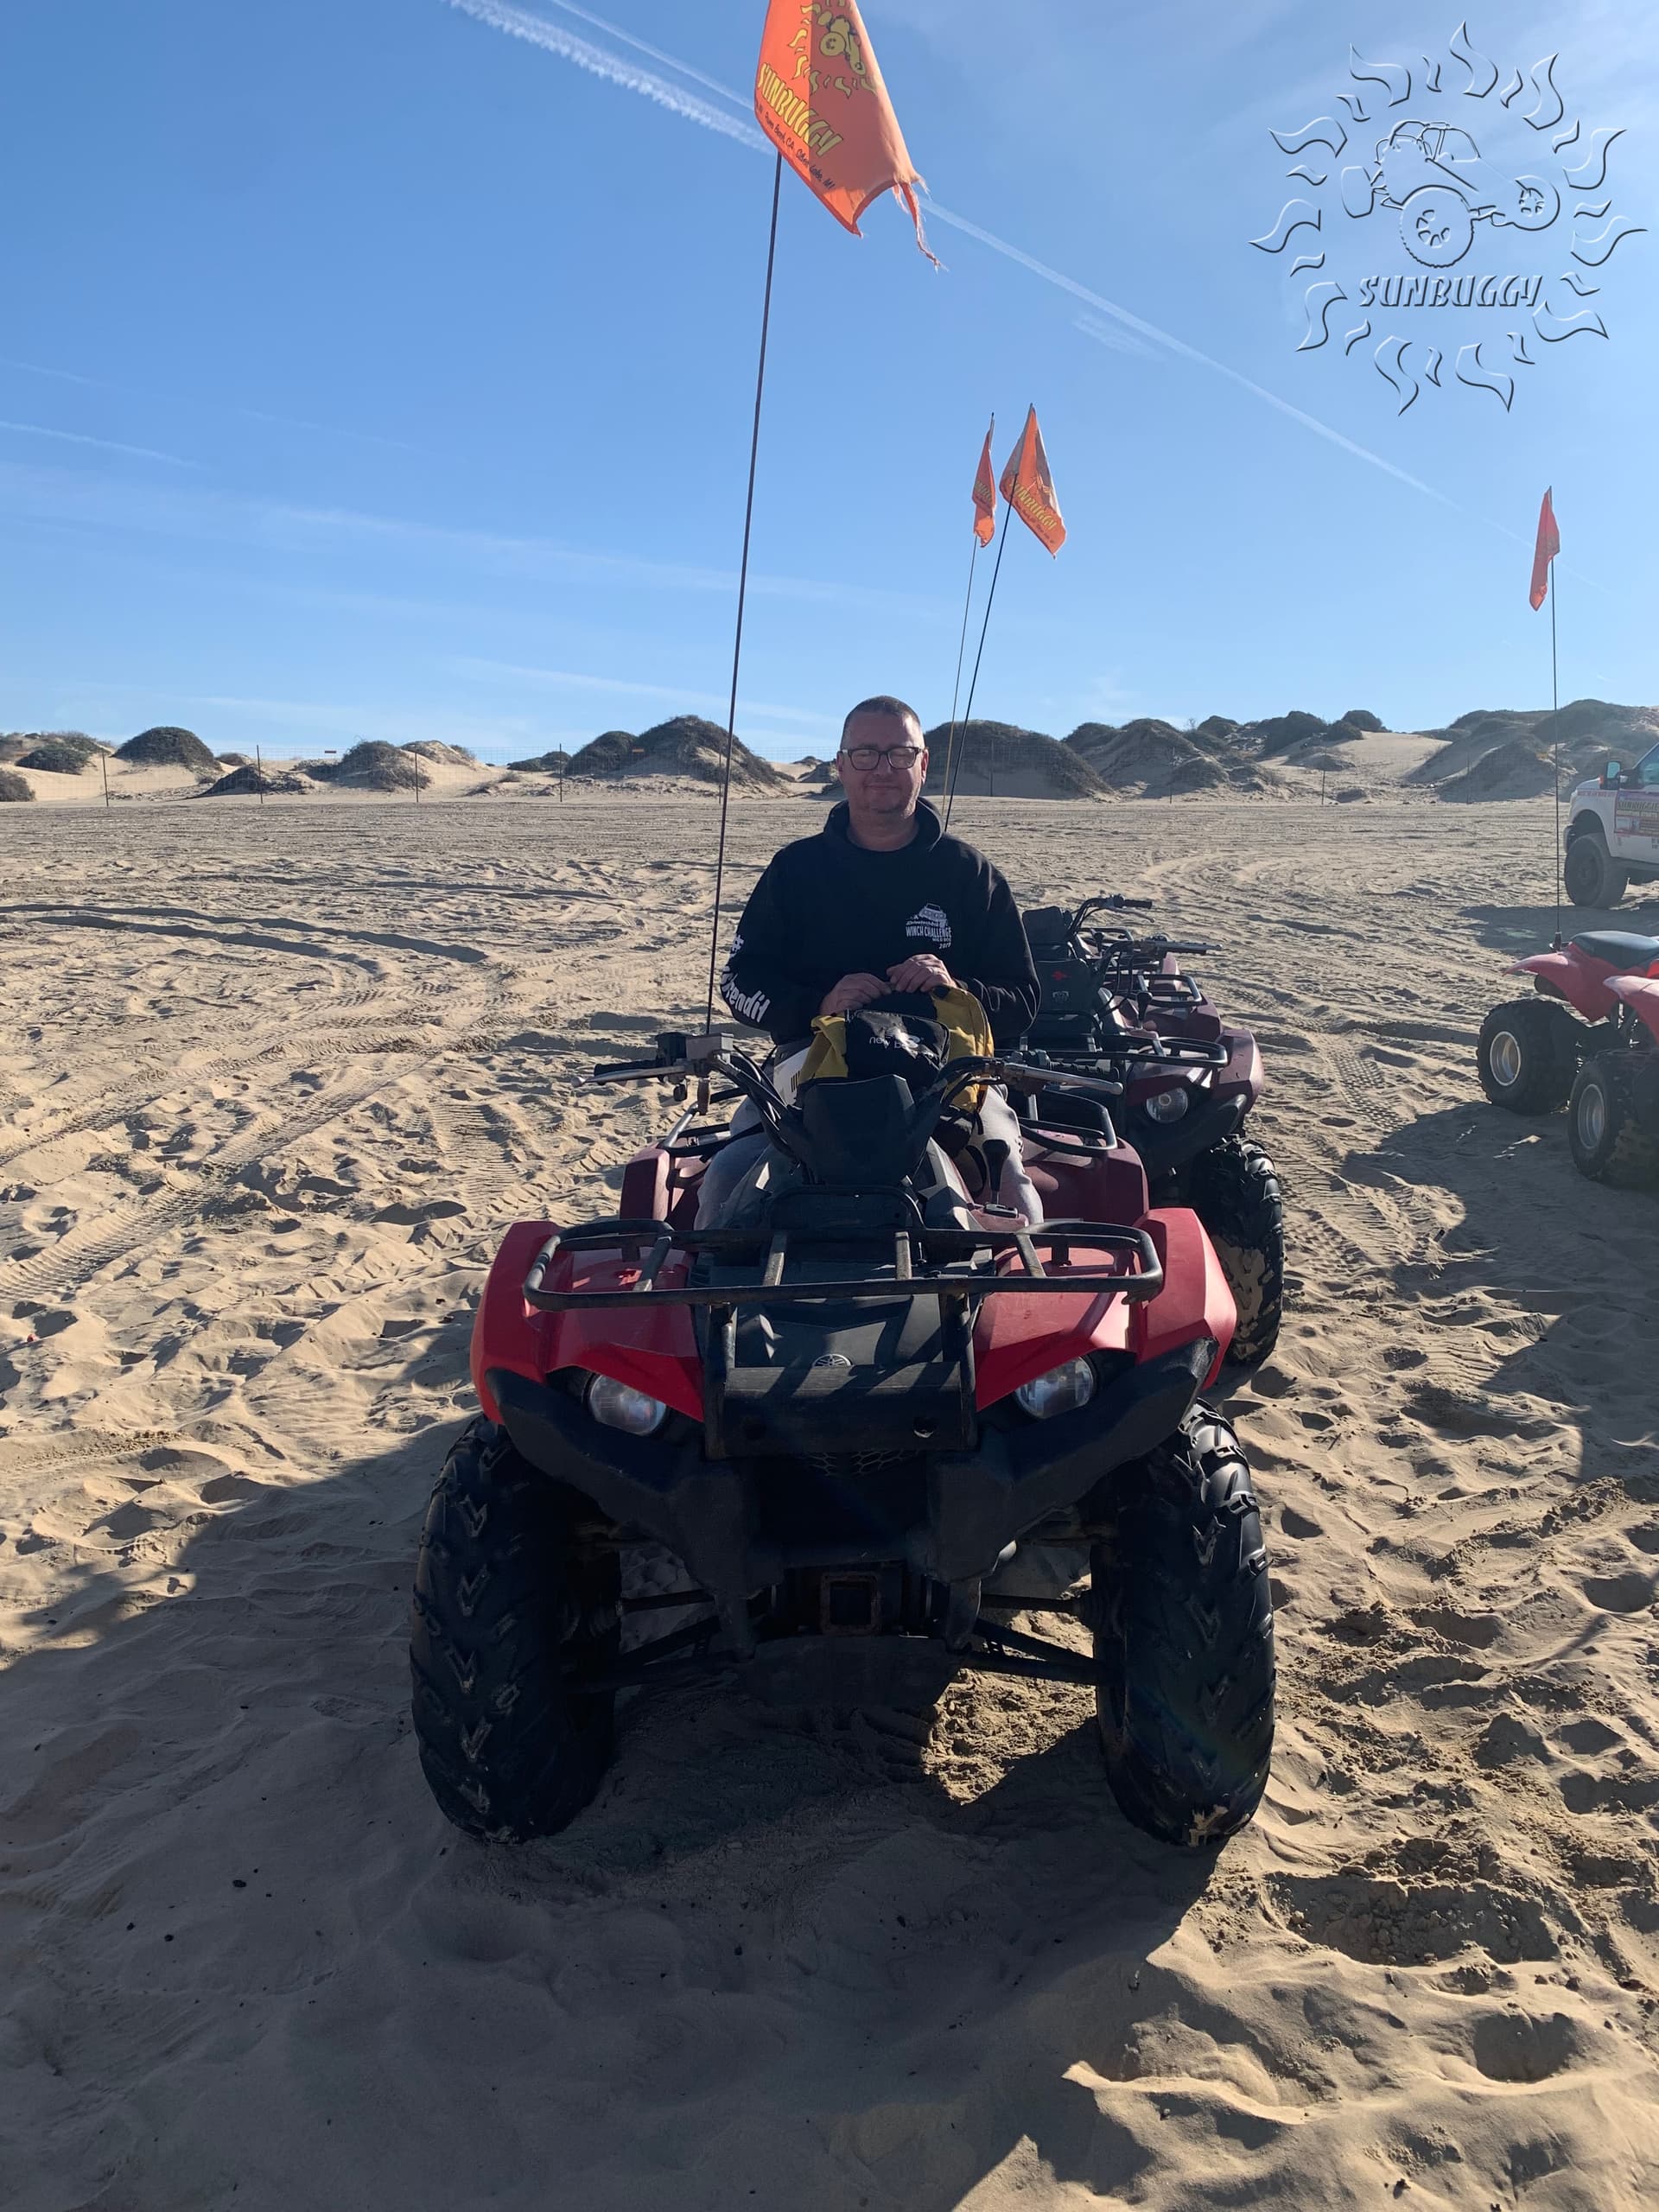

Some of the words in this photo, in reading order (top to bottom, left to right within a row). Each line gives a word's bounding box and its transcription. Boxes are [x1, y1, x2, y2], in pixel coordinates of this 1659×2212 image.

[757, 62, 844, 157] SUNBUGGY
[906, 925, 924, 938] WINCH
[924, 926, 952, 938] CHALLENGE
